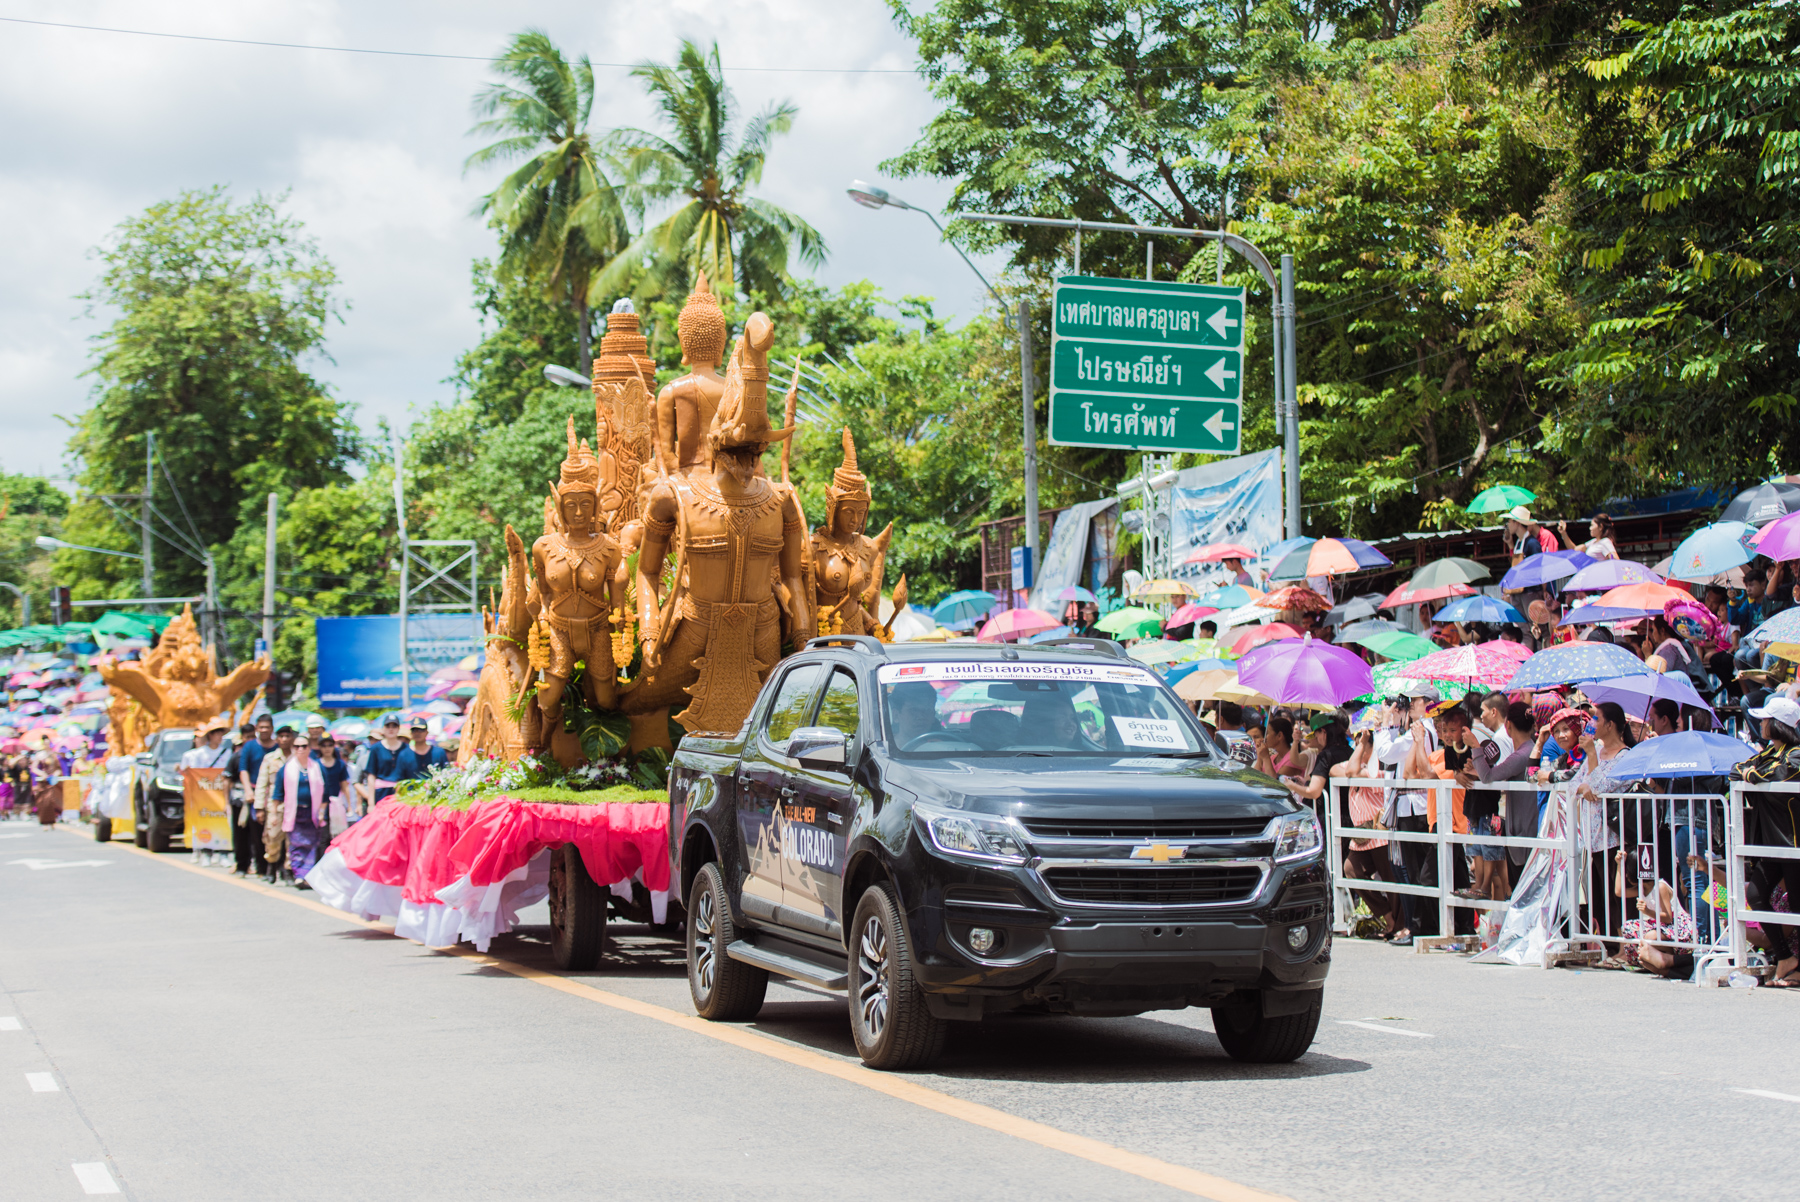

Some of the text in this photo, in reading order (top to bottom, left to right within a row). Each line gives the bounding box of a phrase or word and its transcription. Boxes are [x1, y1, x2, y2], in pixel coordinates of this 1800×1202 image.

[1060, 301, 1199, 338] เทศบาลนครอุบลฯ
[1074, 346, 1182, 386] ไปรษณีย์ฯ
[1080, 402, 1180, 438] โทรศัพท์
[1659, 761, 1698, 769] watsons
[784, 805, 794, 821] THE
[794, 806, 816, 823] ALL-NEW
[781, 826, 835, 868] COLORADO
